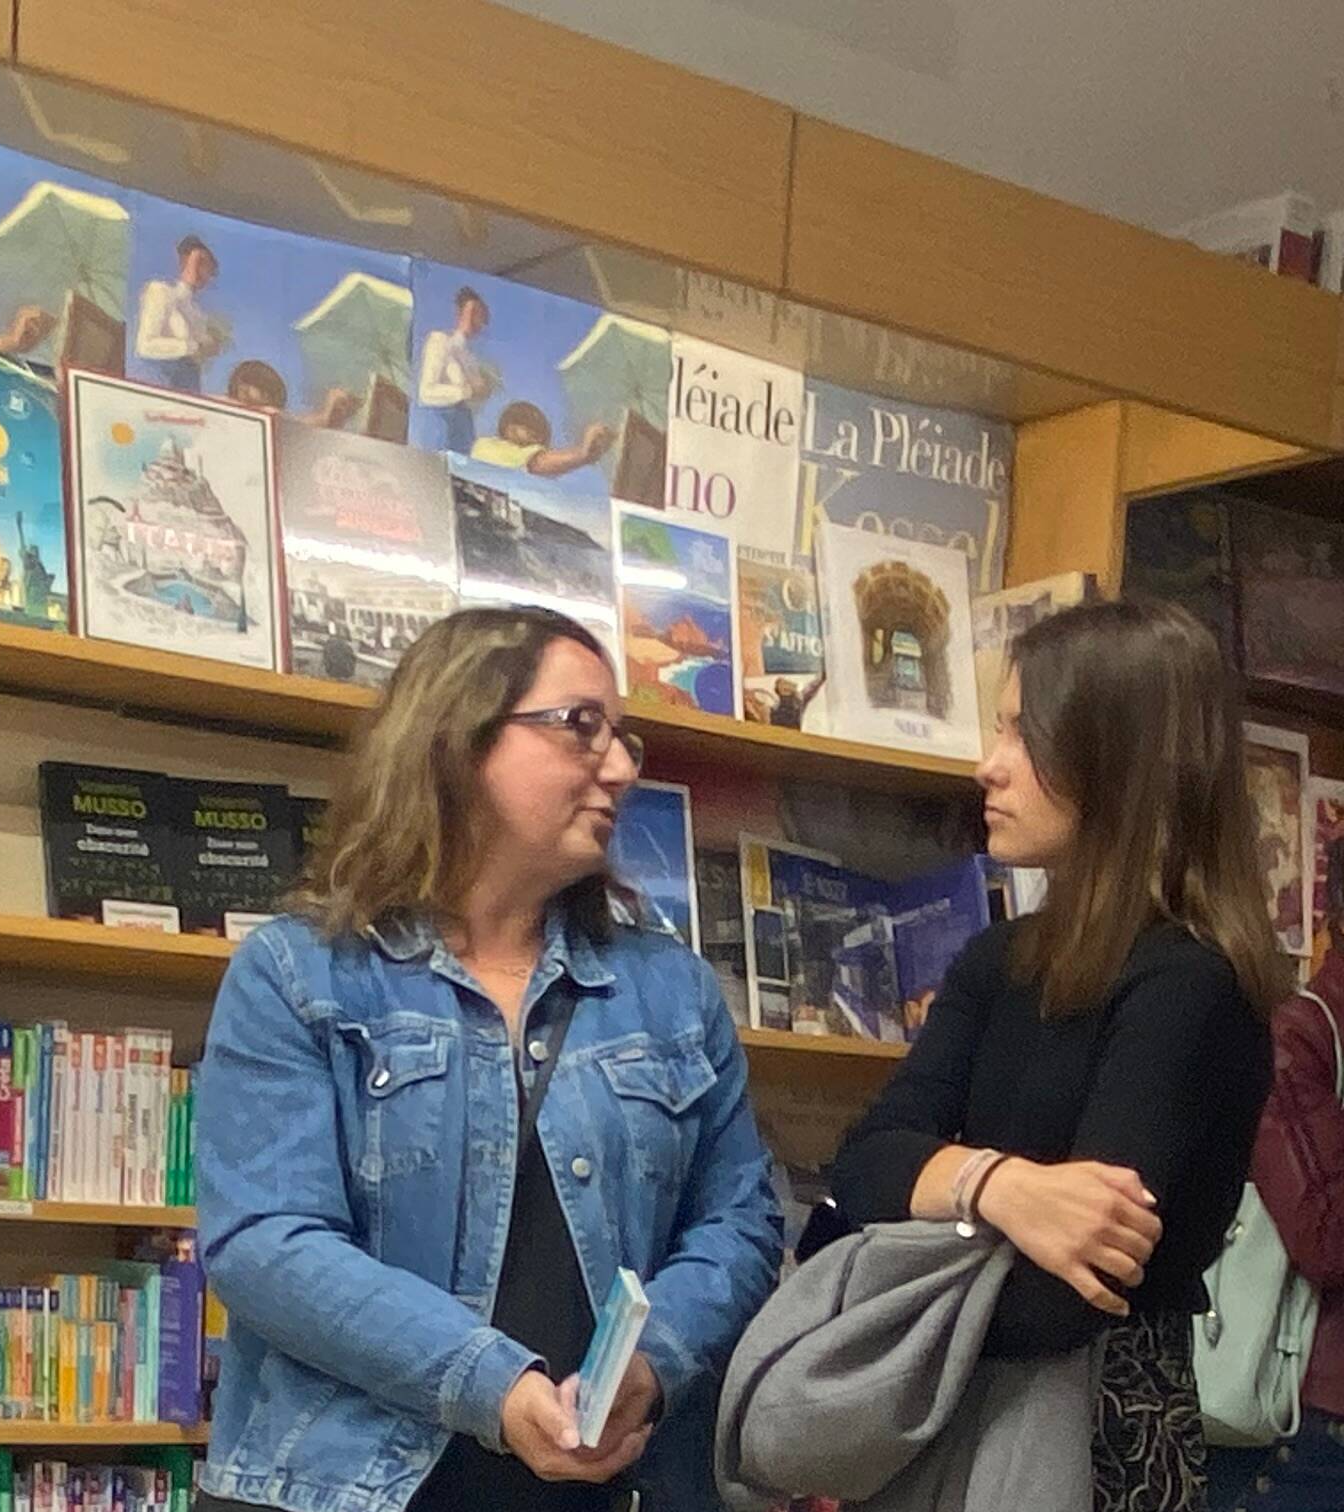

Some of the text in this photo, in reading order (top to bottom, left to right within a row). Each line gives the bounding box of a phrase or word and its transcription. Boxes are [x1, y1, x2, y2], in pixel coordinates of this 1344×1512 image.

[804, 390, 1007, 494] La Pléiade
[72, 795, 147, 819] MUSSO
[194, 809, 268, 830] MUSSO
